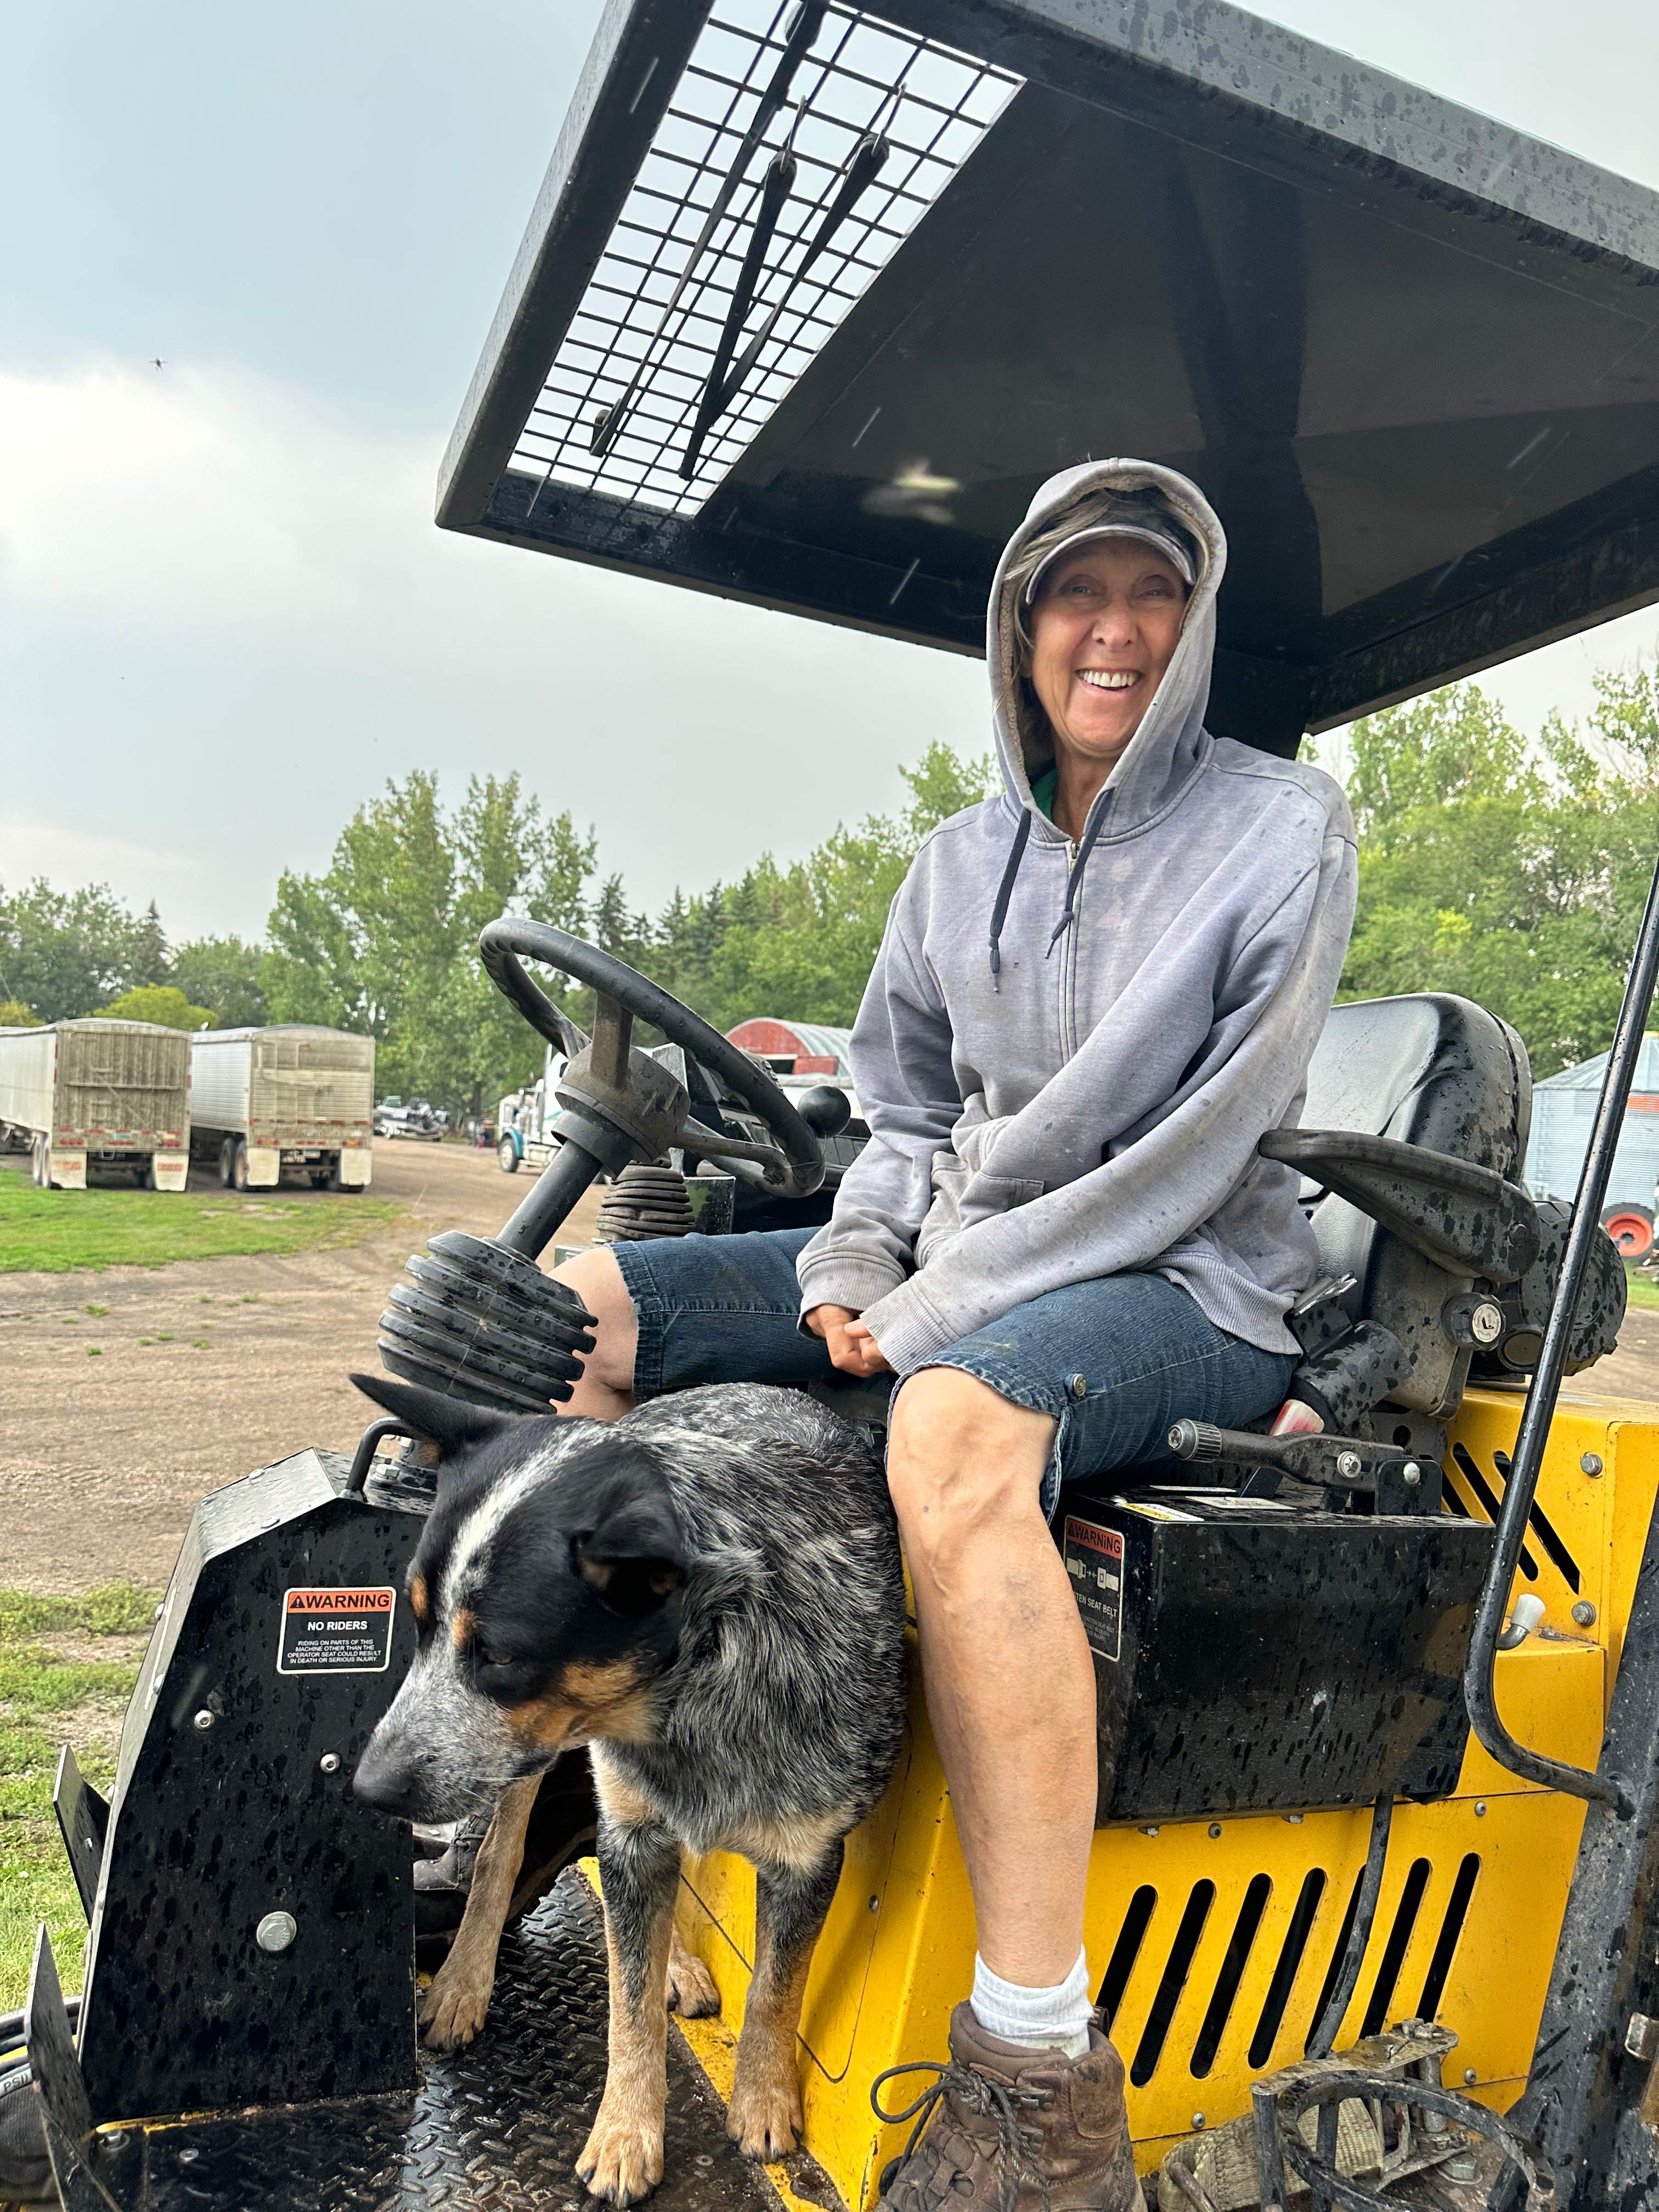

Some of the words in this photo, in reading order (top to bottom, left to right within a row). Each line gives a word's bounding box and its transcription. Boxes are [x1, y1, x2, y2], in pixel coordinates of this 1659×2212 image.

[1075, 1525, 1121, 1554] WARNING
[306, 1594, 390, 1609] WARNING
[1087, 1597, 1102, 1611] SEAT
[1103, 1604, 1118, 1617] BELT
[307, 1621, 324, 1631] NO
[326, 1621, 368, 1630] RIDERS
